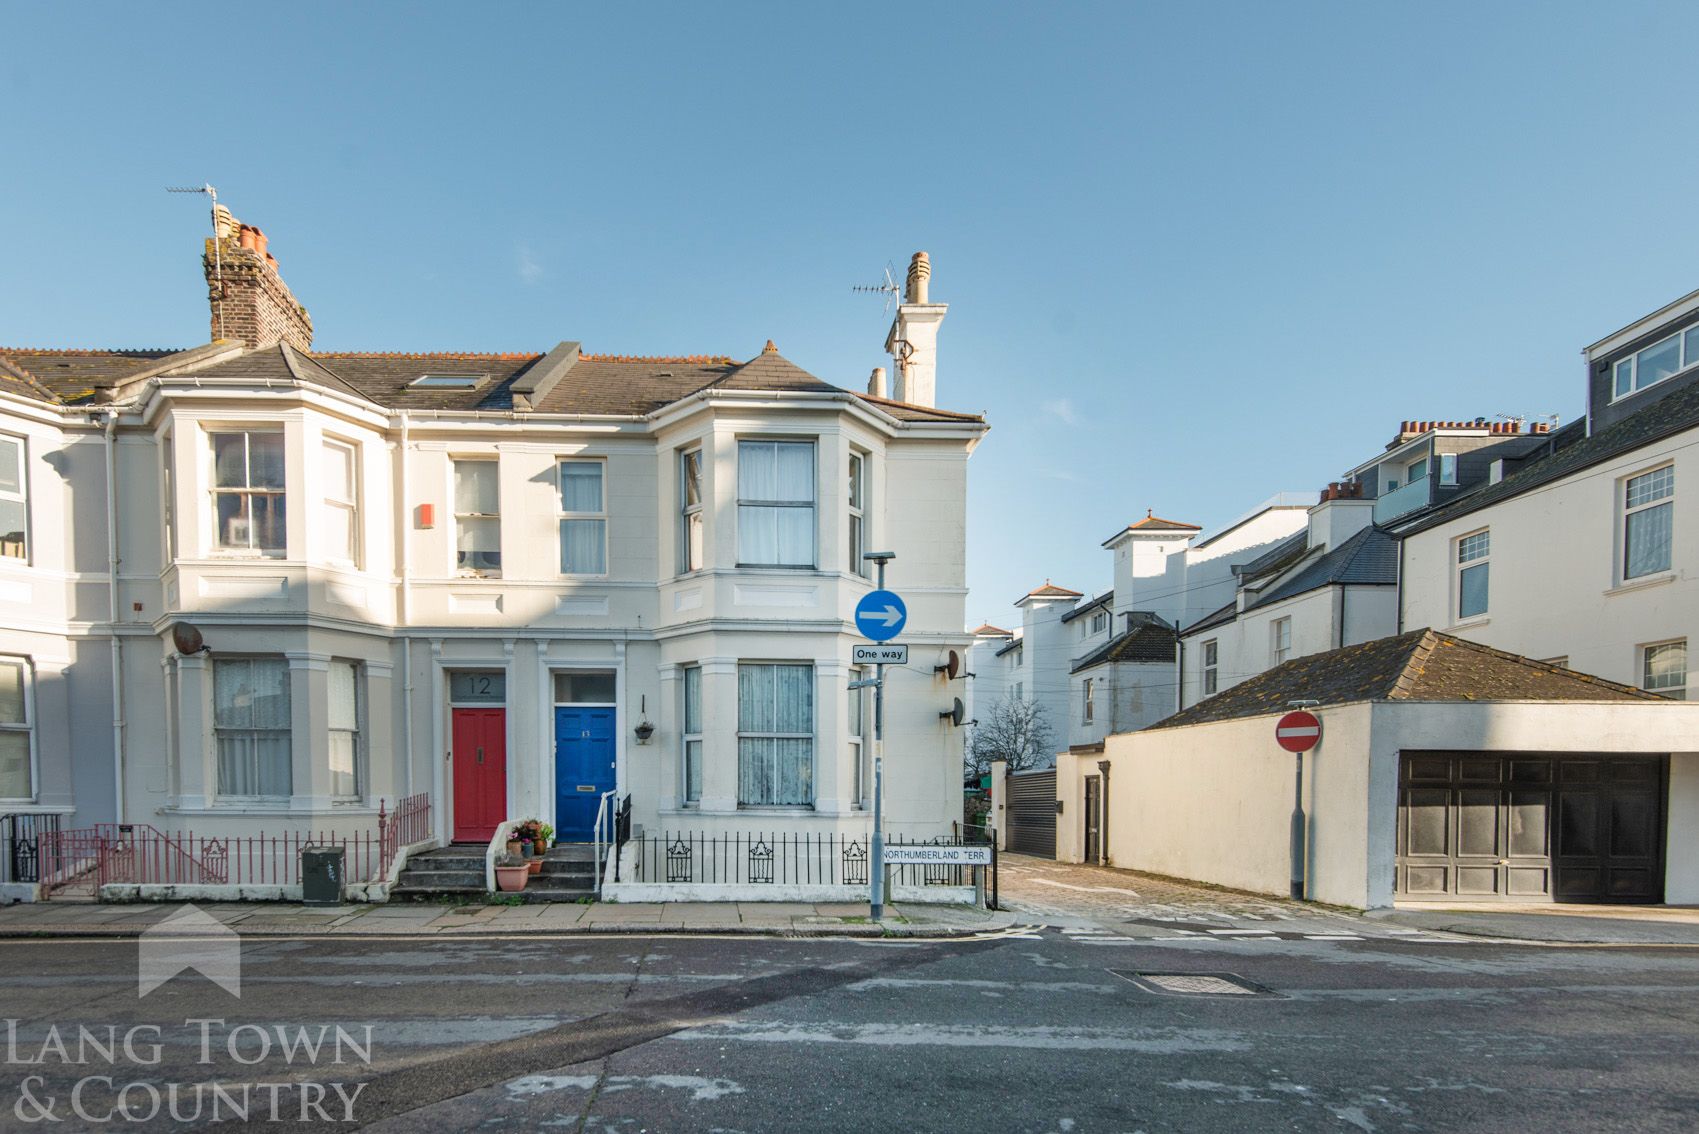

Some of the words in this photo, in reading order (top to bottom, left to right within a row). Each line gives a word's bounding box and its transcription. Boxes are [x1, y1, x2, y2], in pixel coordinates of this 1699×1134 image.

[857, 650, 877, 659] One
[881, 651, 903, 659] way
[470, 677, 491, 695] 12
